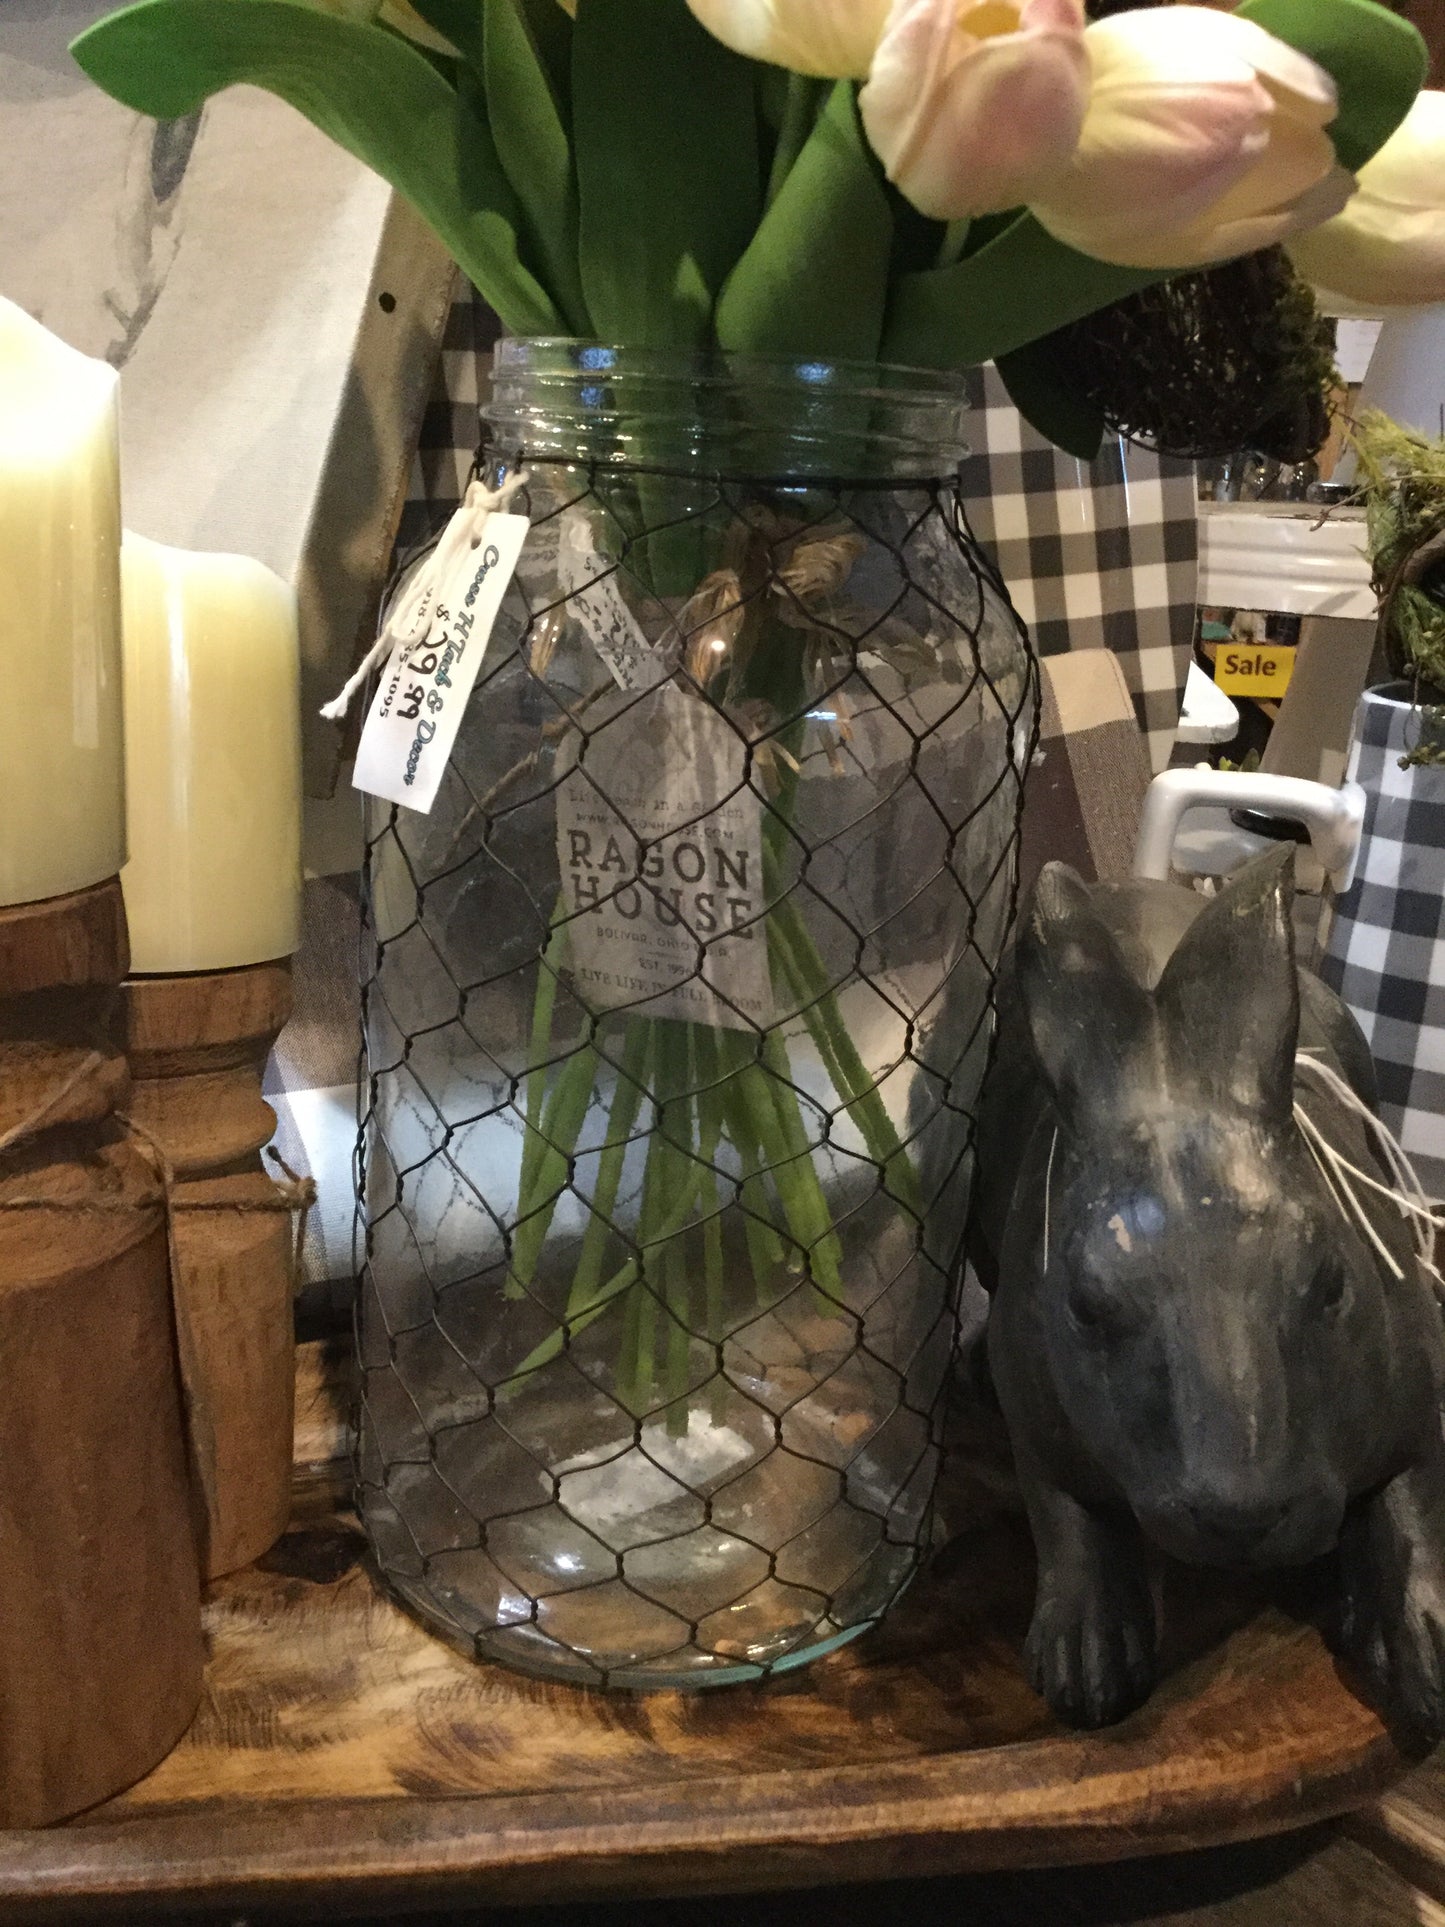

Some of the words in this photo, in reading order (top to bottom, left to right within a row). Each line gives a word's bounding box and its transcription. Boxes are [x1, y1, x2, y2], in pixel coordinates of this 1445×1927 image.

[465, 545, 499, 607] Cross
[453, 610, 475, 639] H
[434, 639, 466, 688] Tack
[1224, 654, 1277, 676] Sale
[427, 690, 444, 714] &
[403, 720, 436, 785] Decor
[567, 829, 748, 891] RAGON
[571, 873, 753, 939] HOUSE
[581, 968, 611, 985] LIVE
[712, 993, 763, 1012] BOOM
